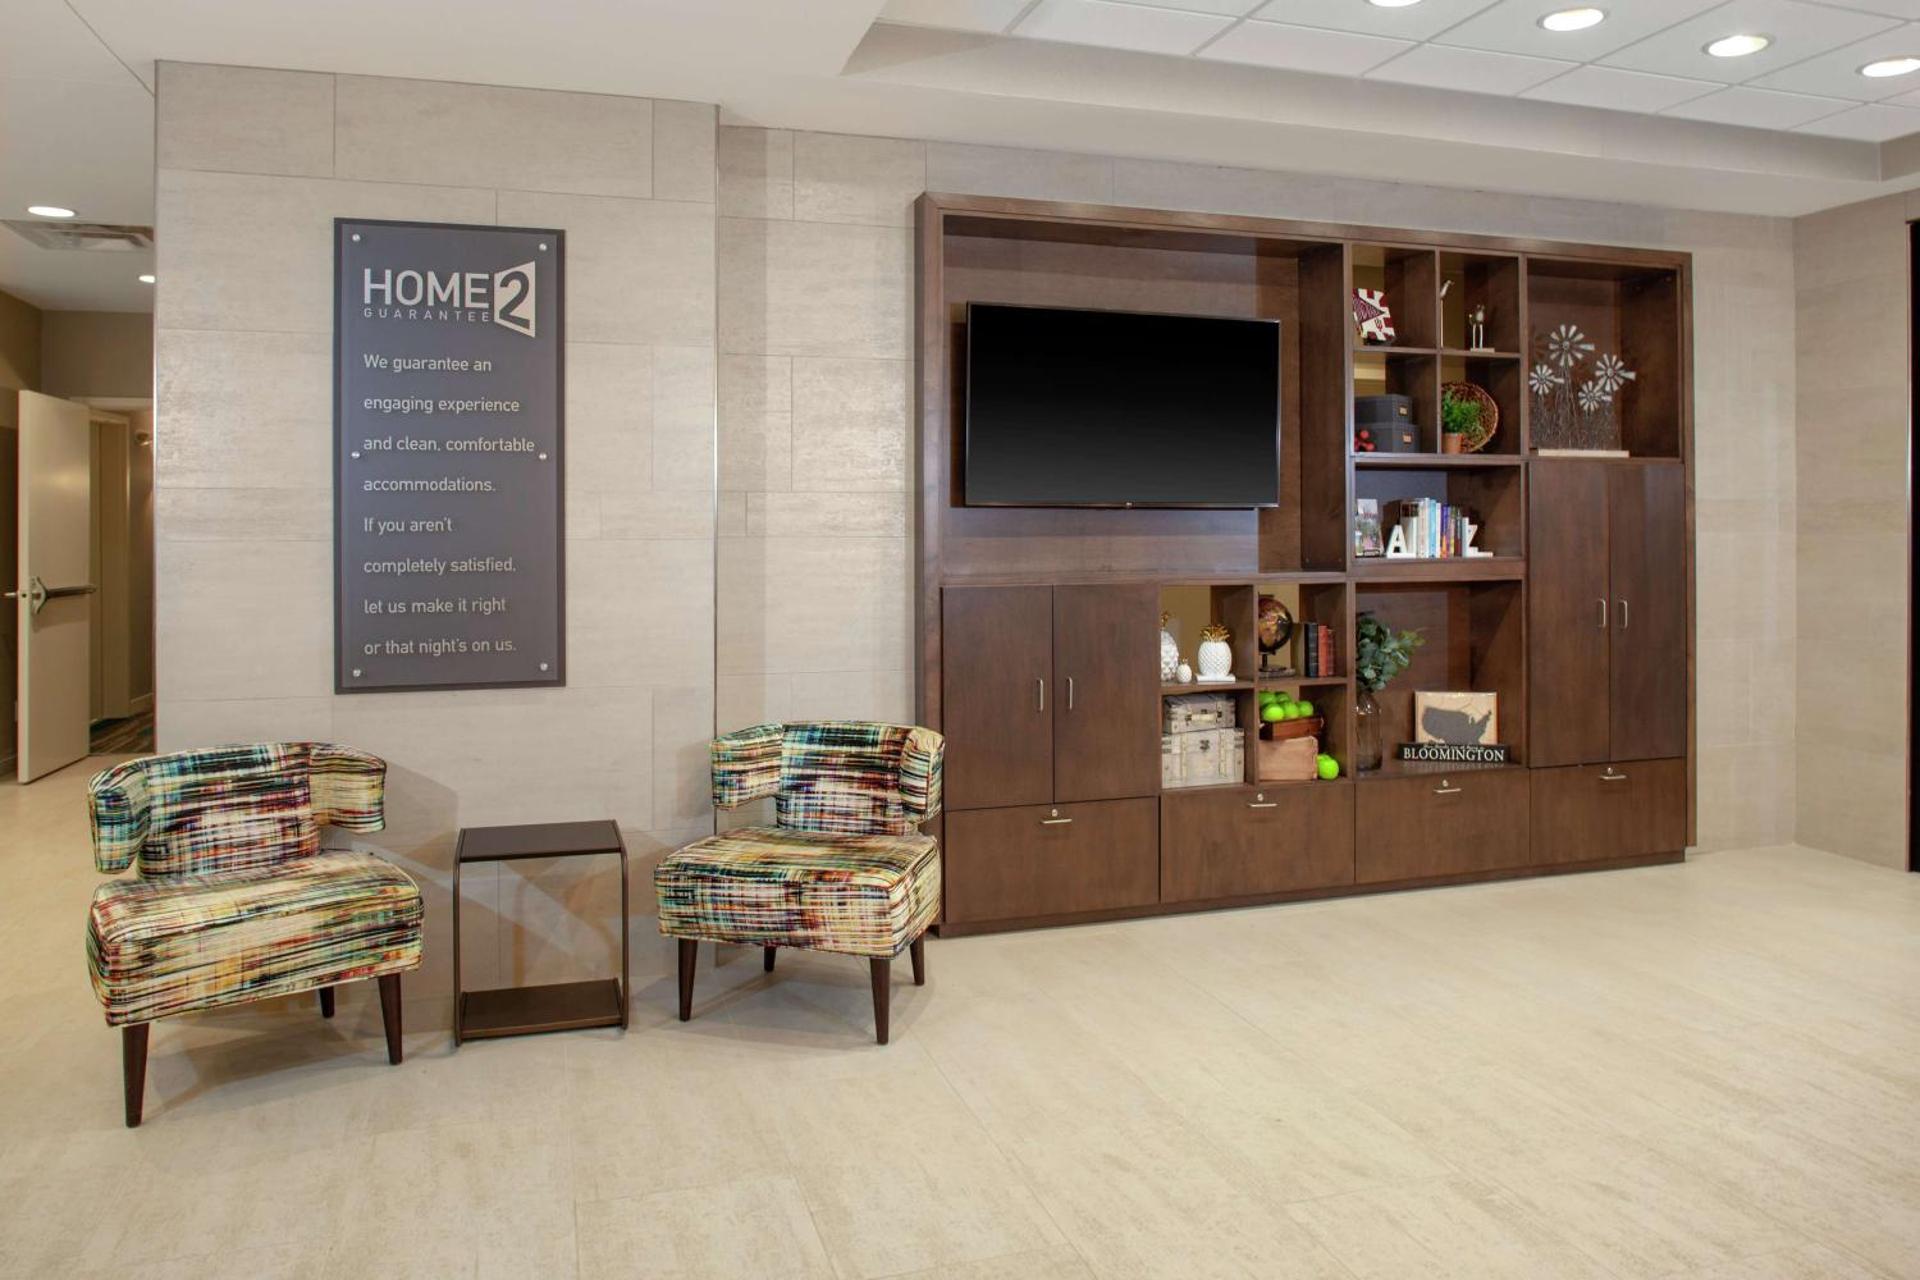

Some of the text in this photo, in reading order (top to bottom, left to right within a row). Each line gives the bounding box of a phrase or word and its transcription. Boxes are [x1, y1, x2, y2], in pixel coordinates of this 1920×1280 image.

[364, 308, 491, 322] GUARANTEE
[364, 354, 492, 373] We guarantee an
[364, 396, 520, 414] engaging experience
[364, 436, 392, 450] and
[446, 437, 535, 453] comfortable
[364, 476, 496, 492] accommodations.
[364, 516, 453, 536] If you aren't
[363, 558, 446, 576] completely
[364, 597, 506, 615] let us make it right
[364, 639, 517, 657] or that night's on us.
[1403, 747, 1505, 762] BLOOMINGTON
